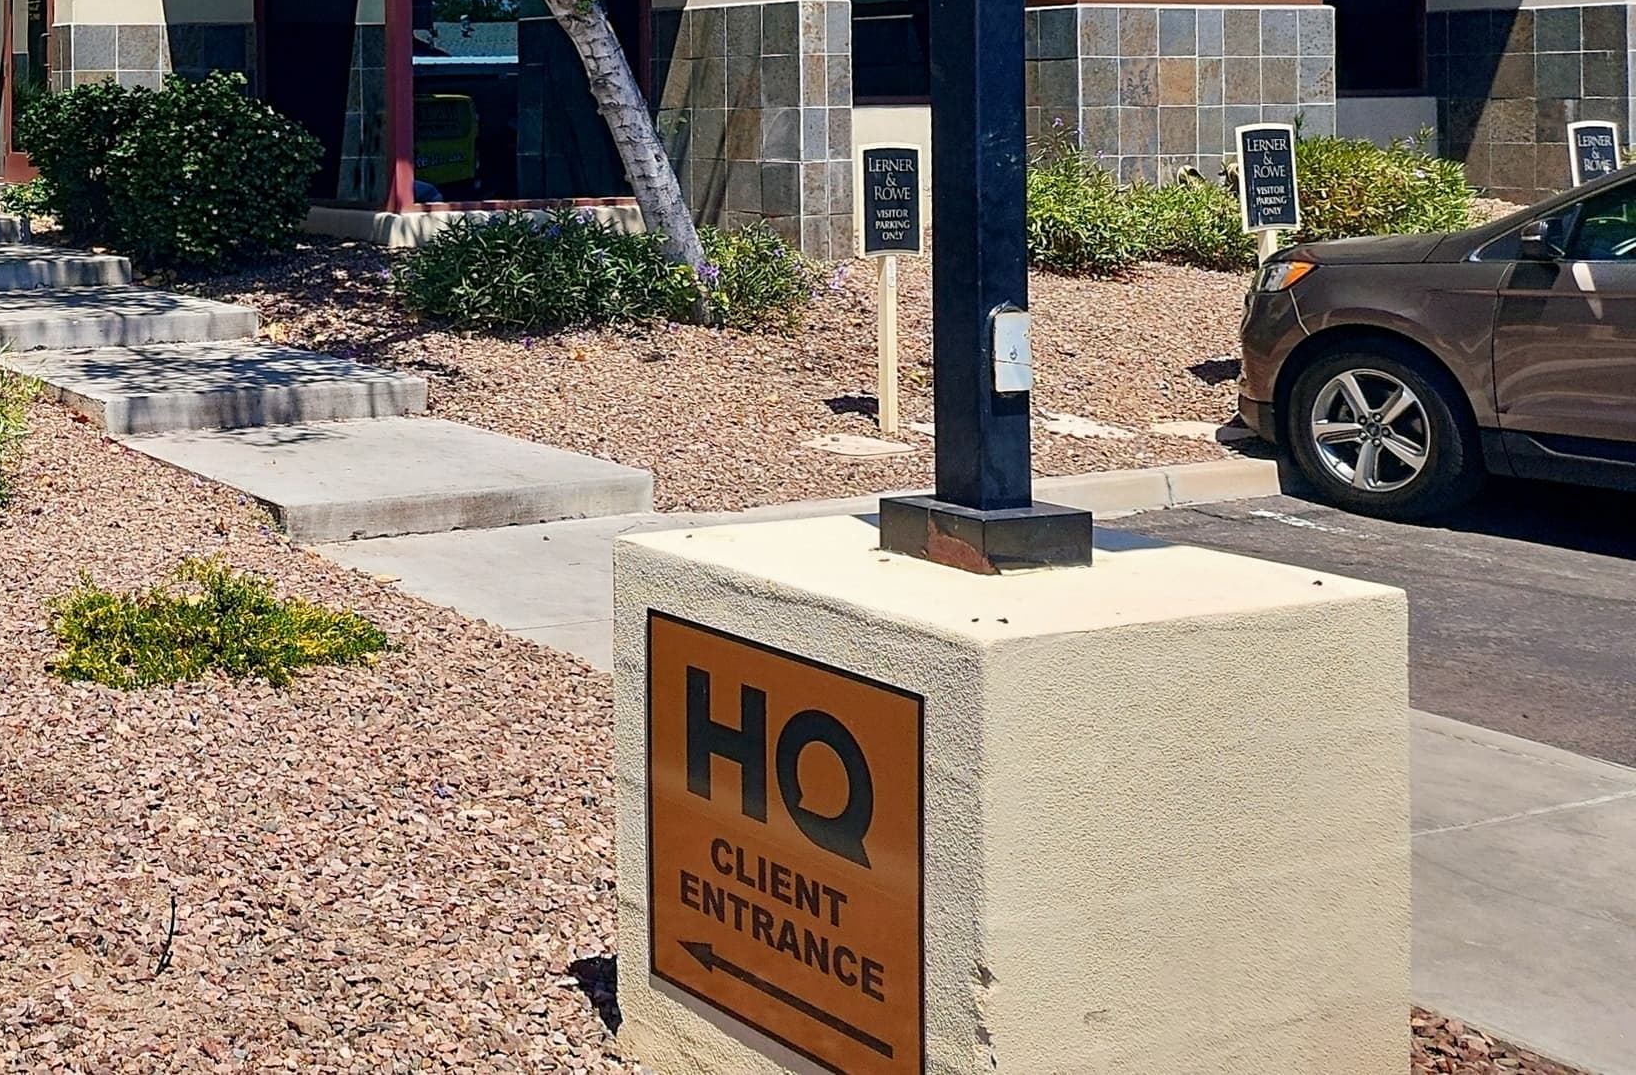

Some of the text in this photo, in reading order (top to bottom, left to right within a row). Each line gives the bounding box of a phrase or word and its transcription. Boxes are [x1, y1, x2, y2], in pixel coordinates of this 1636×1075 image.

[1247, 138, 1287, 151] LERNER
[1577, 134, 1612, 147] LERNER
[1263, 151, 1273, 165] &
[1592, 147, 1600, 159] &
[868, 157, 915, 172] LERNER
[1584, 159, 1612, 171] ROWE
[1253, 165, 1286, 178] ROWE
[885, 172, 897, 186] &
[874, 186, 910, 200] ROWE
[1256, 186, 1285, 194] VISITOR
[1256, 197, 1287, 206] PARKING
[876, 209, 908, 218] VISITOR
[1263, 207, 1282, 215] ONLY
[875, 221, 910, 229] PARKING
[882, 231, 904, 240] ONLY
[685, 664, 875, 870] HQ
[710, 837, 848, 928] CLIENT
[680, 869, 885, 1002] ENTRANCE
